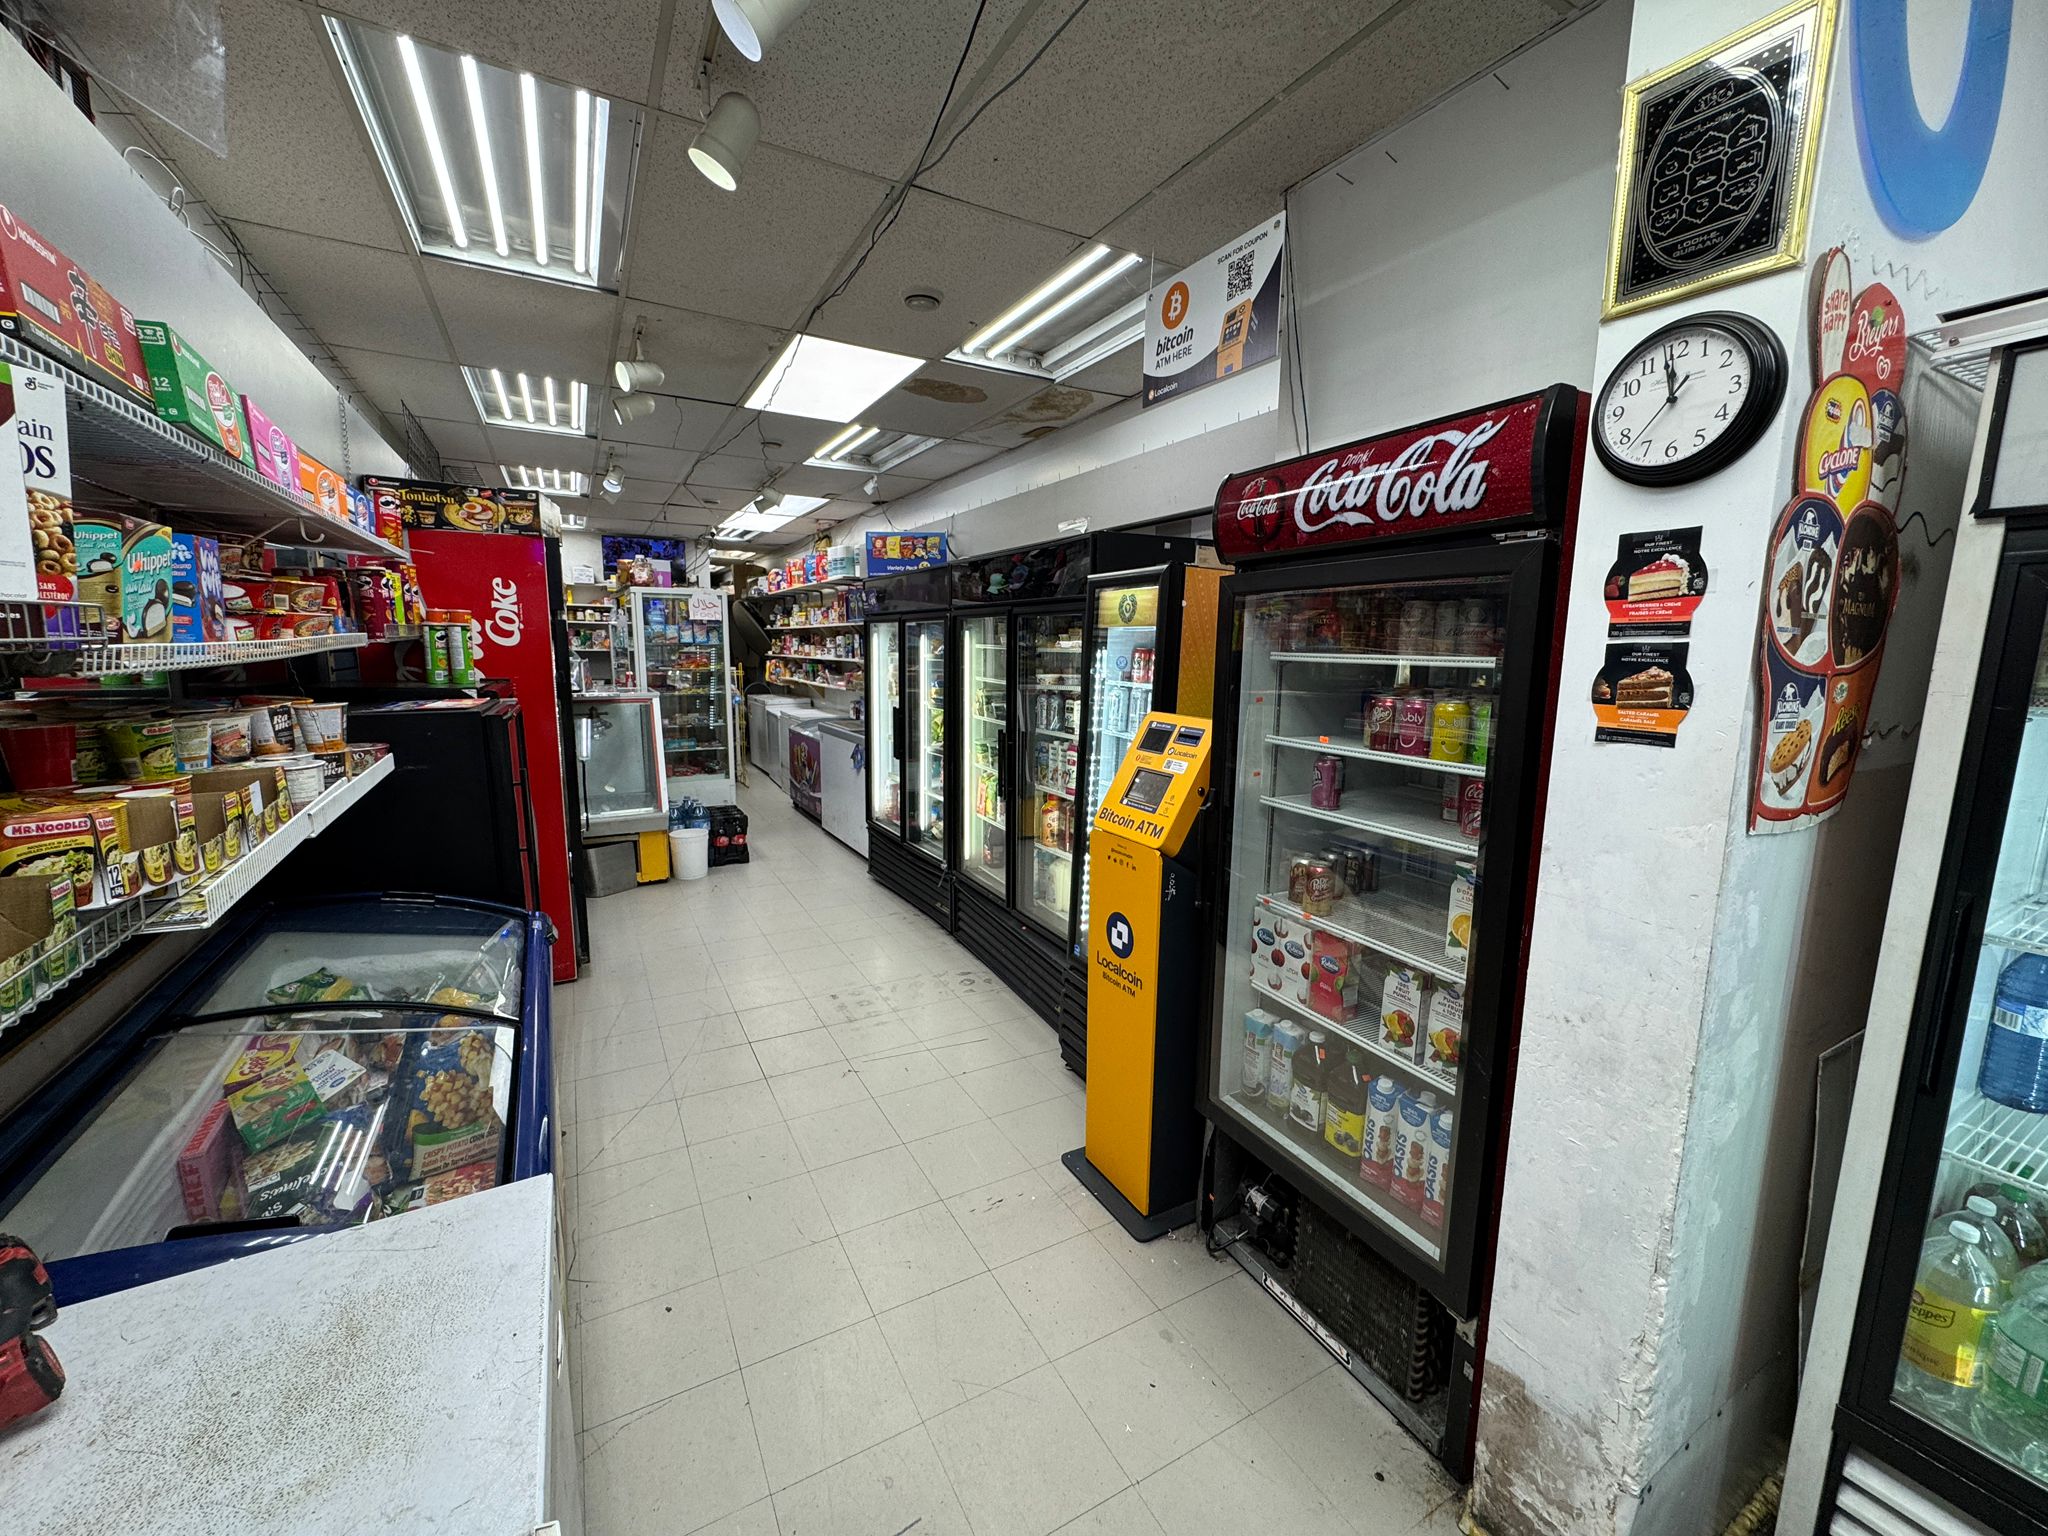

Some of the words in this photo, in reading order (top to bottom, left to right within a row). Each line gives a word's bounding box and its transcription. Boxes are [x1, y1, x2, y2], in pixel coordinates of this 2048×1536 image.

[1243, 230, 1268, 252] COUPON
[1155, 325, 1194, 357] bitcoin
[1849, 309, 1899, 362] Breyers
[1154, 354, 1171, 370] ATM
[1172, 344, 1193, 363] HERE
[1667, 339, 1690, 362] 12
[1700, 339, 1709, 358] 1
[1640, 357, 1657, 377] 11
[1718, 349, 1734, 369] 2
[151, 376, 171, 388] 12
[1154, 381, 1179, 398] Localcoin
[1622, 378, 1642, 398] 10
[1728, 374, 1743, 394] 3
[1612, 405, 1626, 423] 9
[1714, 402, 1730, 421] 4
[1619, 427, 1632, 445] 8
[1693, 428, 1707, 447] 5
[1342, 448, 1374, 467] Drink!
[1640, 440, 1653, 458] 7
[1664, 440, 1679, 458] 6
[1819, 446, 1860, 477] CYCLONE
[399, 488, 455, 505] Tonkotsu
[127, 550, 172, 574] Whippet
[886, 565, 904, 573] Variety
[38, 582, 56, 590] SANS
[485, 576, 522, 648] Coke
[1843, 600, 1877, 617] MAGNUM
[35, 820, 89, 833] NOODLES
[1099, 806, 1135, 830] Bitcoin
[1135, 820, 1165, 840] ATM
[109, 866, 121, 886] 12
[1097, 950, 1143, 990] Localcoin
[1102, 971, 1122, 989] Bitcoin
[1121, 984, 1136, 998] ATM
[1392, 991, 1411, 1001] PUNCH
[1443, 996, 1463, 1008] PUNCH
[1362, 1118, 1376, 1161] OASIS
[1391, 1131, 1408, 1177] OASIS
[1424, 1155, 1438, 1200] OASIS
